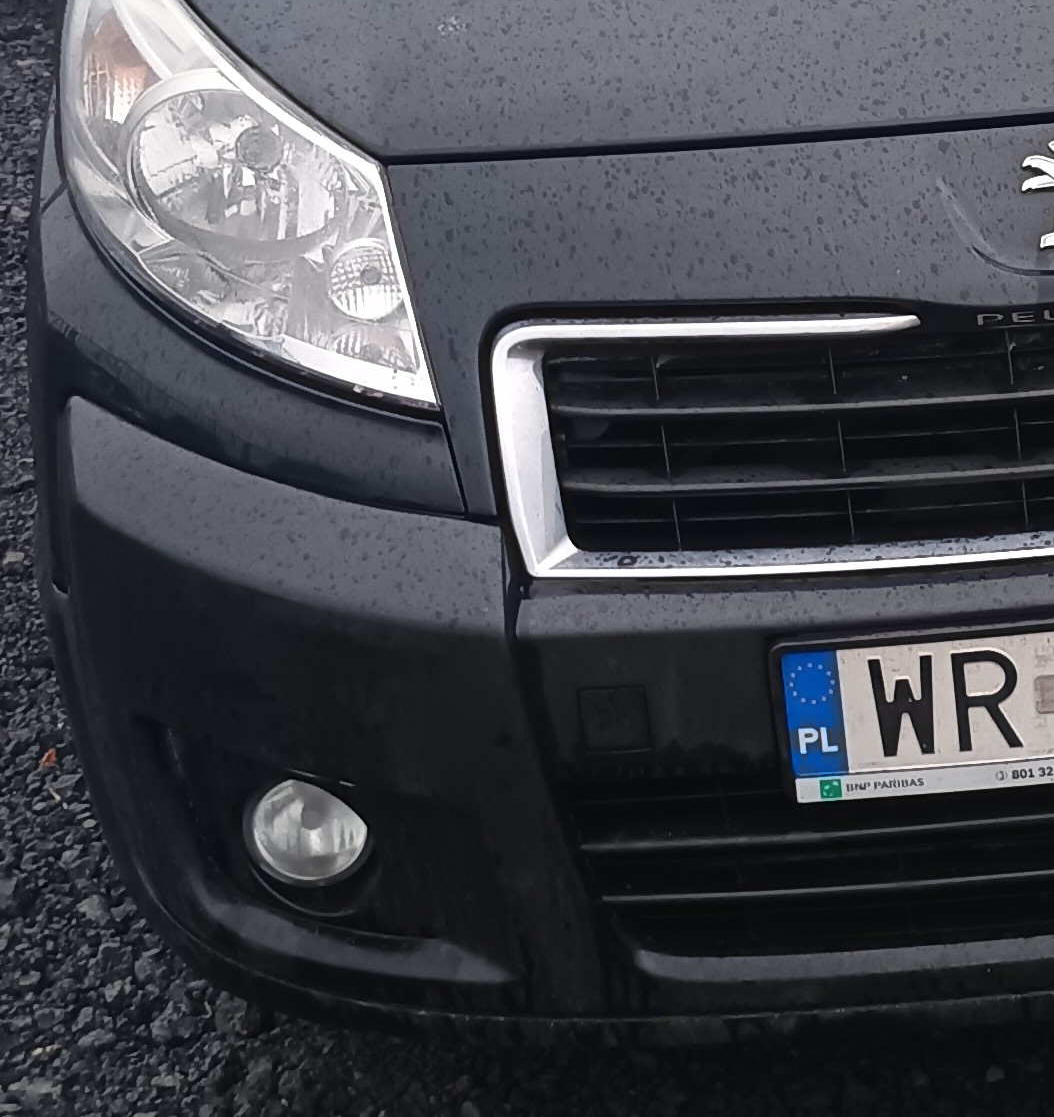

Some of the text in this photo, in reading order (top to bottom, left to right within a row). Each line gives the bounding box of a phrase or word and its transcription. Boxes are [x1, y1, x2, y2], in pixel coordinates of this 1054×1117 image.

[867, 649, 1025, 758] WR
[797, 726, 839, 755] PL
[1011, 767, 1035, 780] 801
[845, 777, 925, 793] BNP PARIBAS
